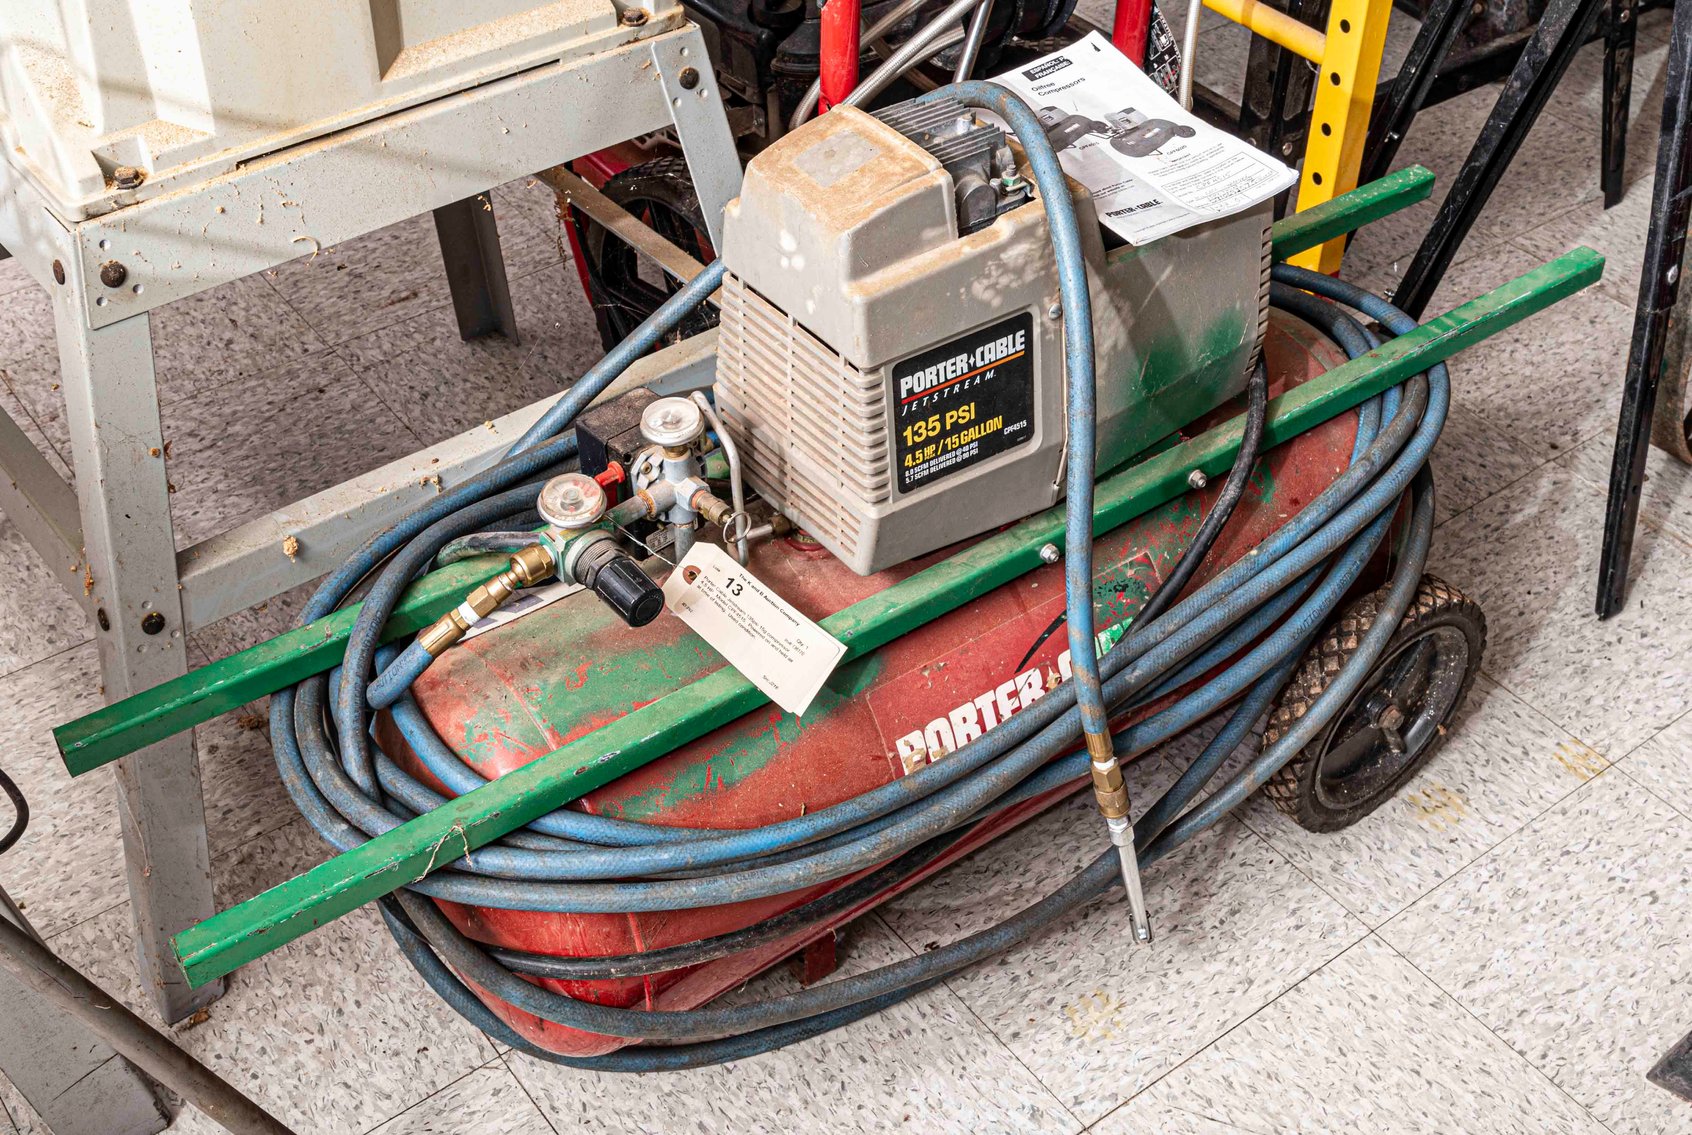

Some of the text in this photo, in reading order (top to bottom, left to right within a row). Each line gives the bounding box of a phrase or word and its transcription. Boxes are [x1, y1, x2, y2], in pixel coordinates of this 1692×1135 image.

[1037, 74, 1086, 98] Compressors
[1105, 204, 1135, 219] PORTER
[1136, 198, 1161, 210] CABLE
[901, 330, 1025, 398] PORTER CABLE
[902, 370, 996, 416] JETSTREAM
[903, 402, 975, 447] 135 PSI
[904, 448, 923, 468] 4.5
[925, 444, 935, 457] HP
[945, 434, 959, 450] 15
[960, 416, 1002, 445] GALLON
[1004, 420, 1027, 435] CPF4515
[915, 461, 929, 473] SCFM
[930, 451, 956, 467] DELIVERED
[915, 468, 929, 480] SCFM
[930, 458, 956, 474] DELIVERED
[699, 588, 710, 598] time
[726, 612, 738, 624] Used
[722, 575, 745, 597] 13
[738, 573, 748, 582] The
[750, 583, 760, 593] and
[762, 594, 780, 610] Auction
[778, 608, 800, 627] Company
[702, 575, 716, 588] Porter
[714, 586, 728, 598] Cable
[726, 596, 747, 616] Jetstream
[765, 631, 790, 653] compressor
[714, 593, 728, 607] Model
[746, 622, 765, 640] Powered
[769, 642, 778, 651] and
[777, 649, 787, 659] held
